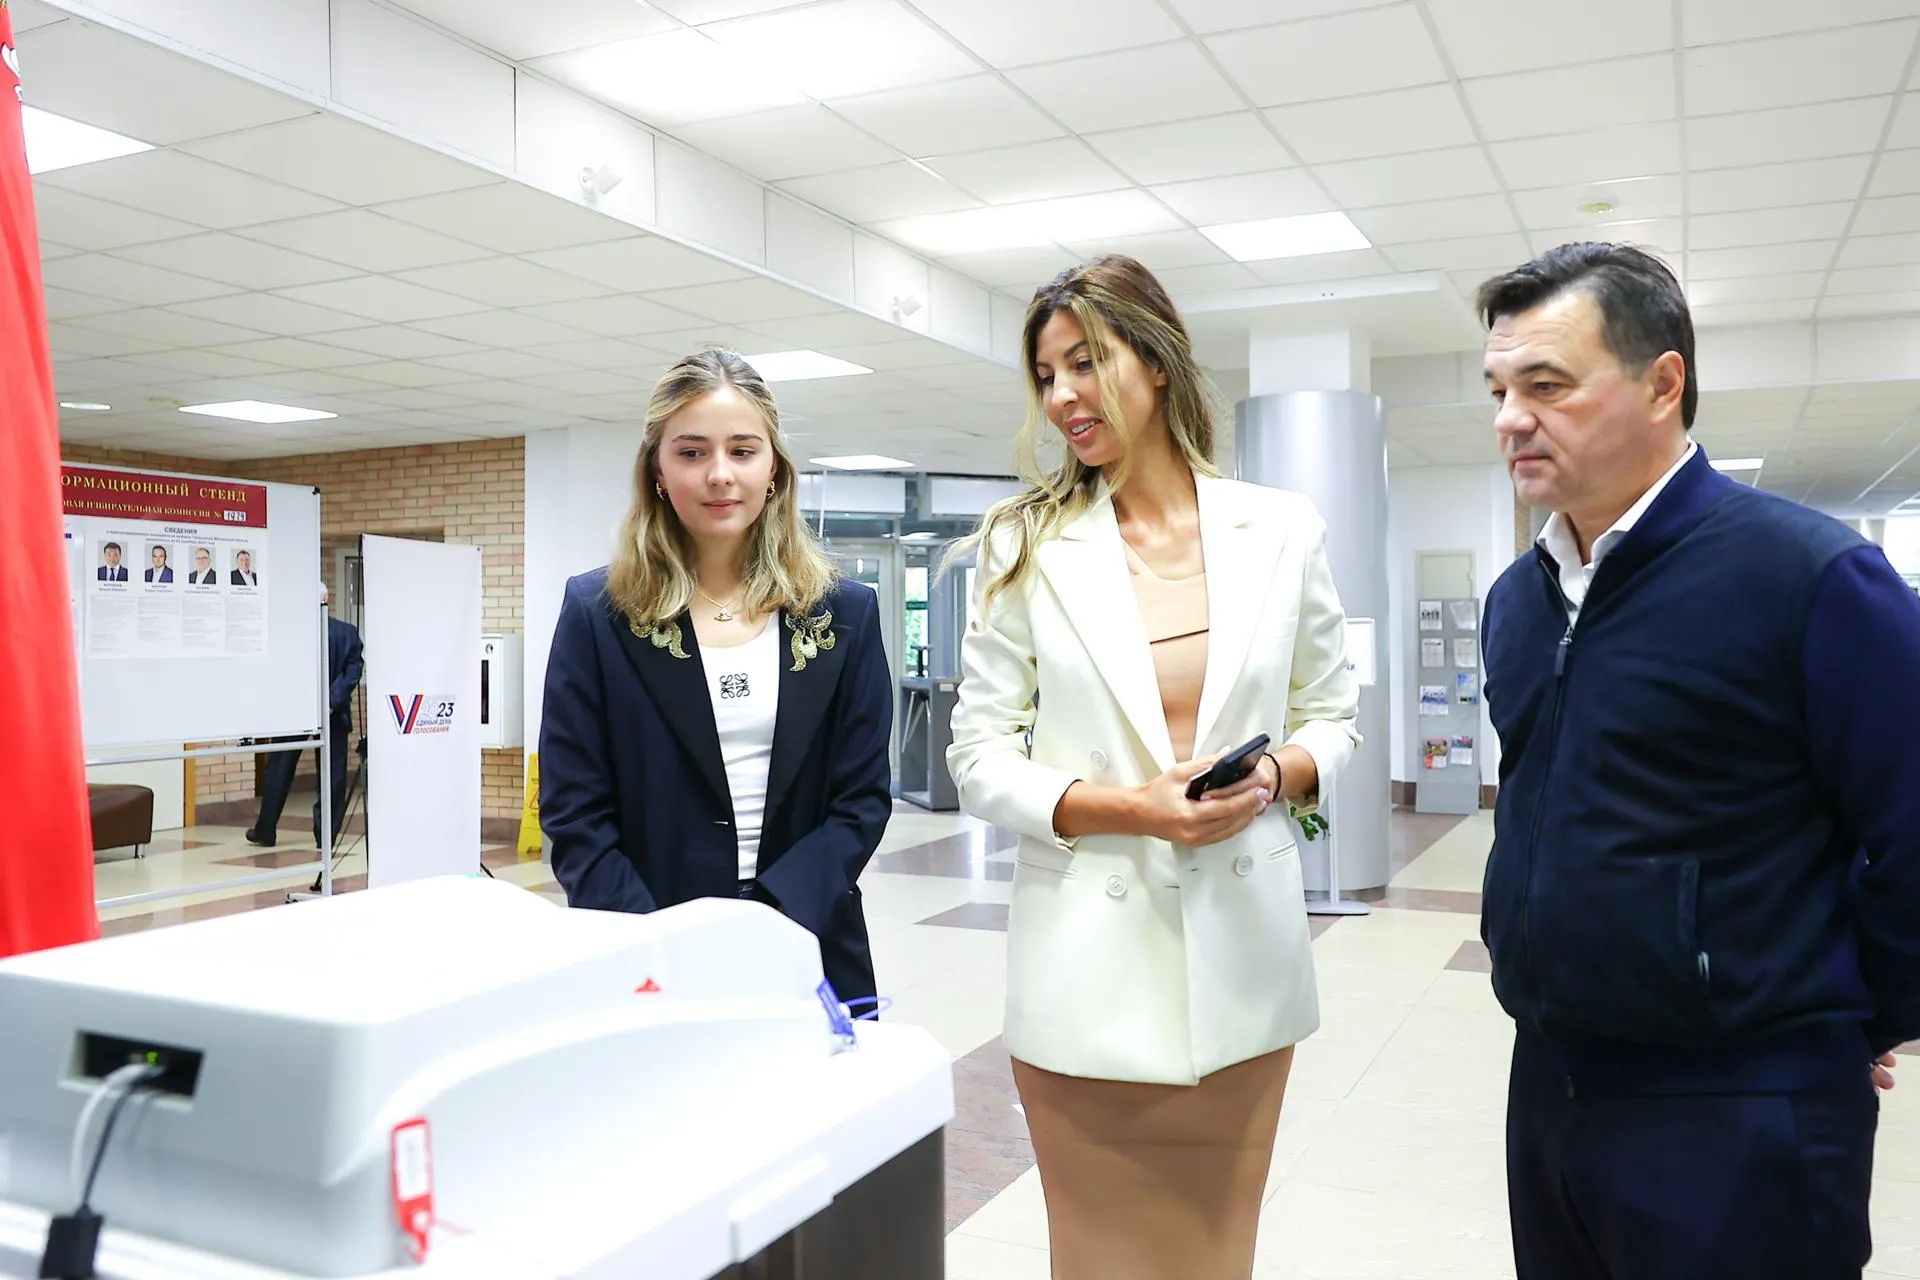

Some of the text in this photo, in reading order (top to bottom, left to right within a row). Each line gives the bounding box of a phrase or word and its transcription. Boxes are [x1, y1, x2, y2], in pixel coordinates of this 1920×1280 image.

[199, 487, 247, 504] СТЕНД
[86, 500, 163, 514] ИЗБИРАТЕЛЬНАЯ
[164, 507, 211, 519] КОМИССИЯ
